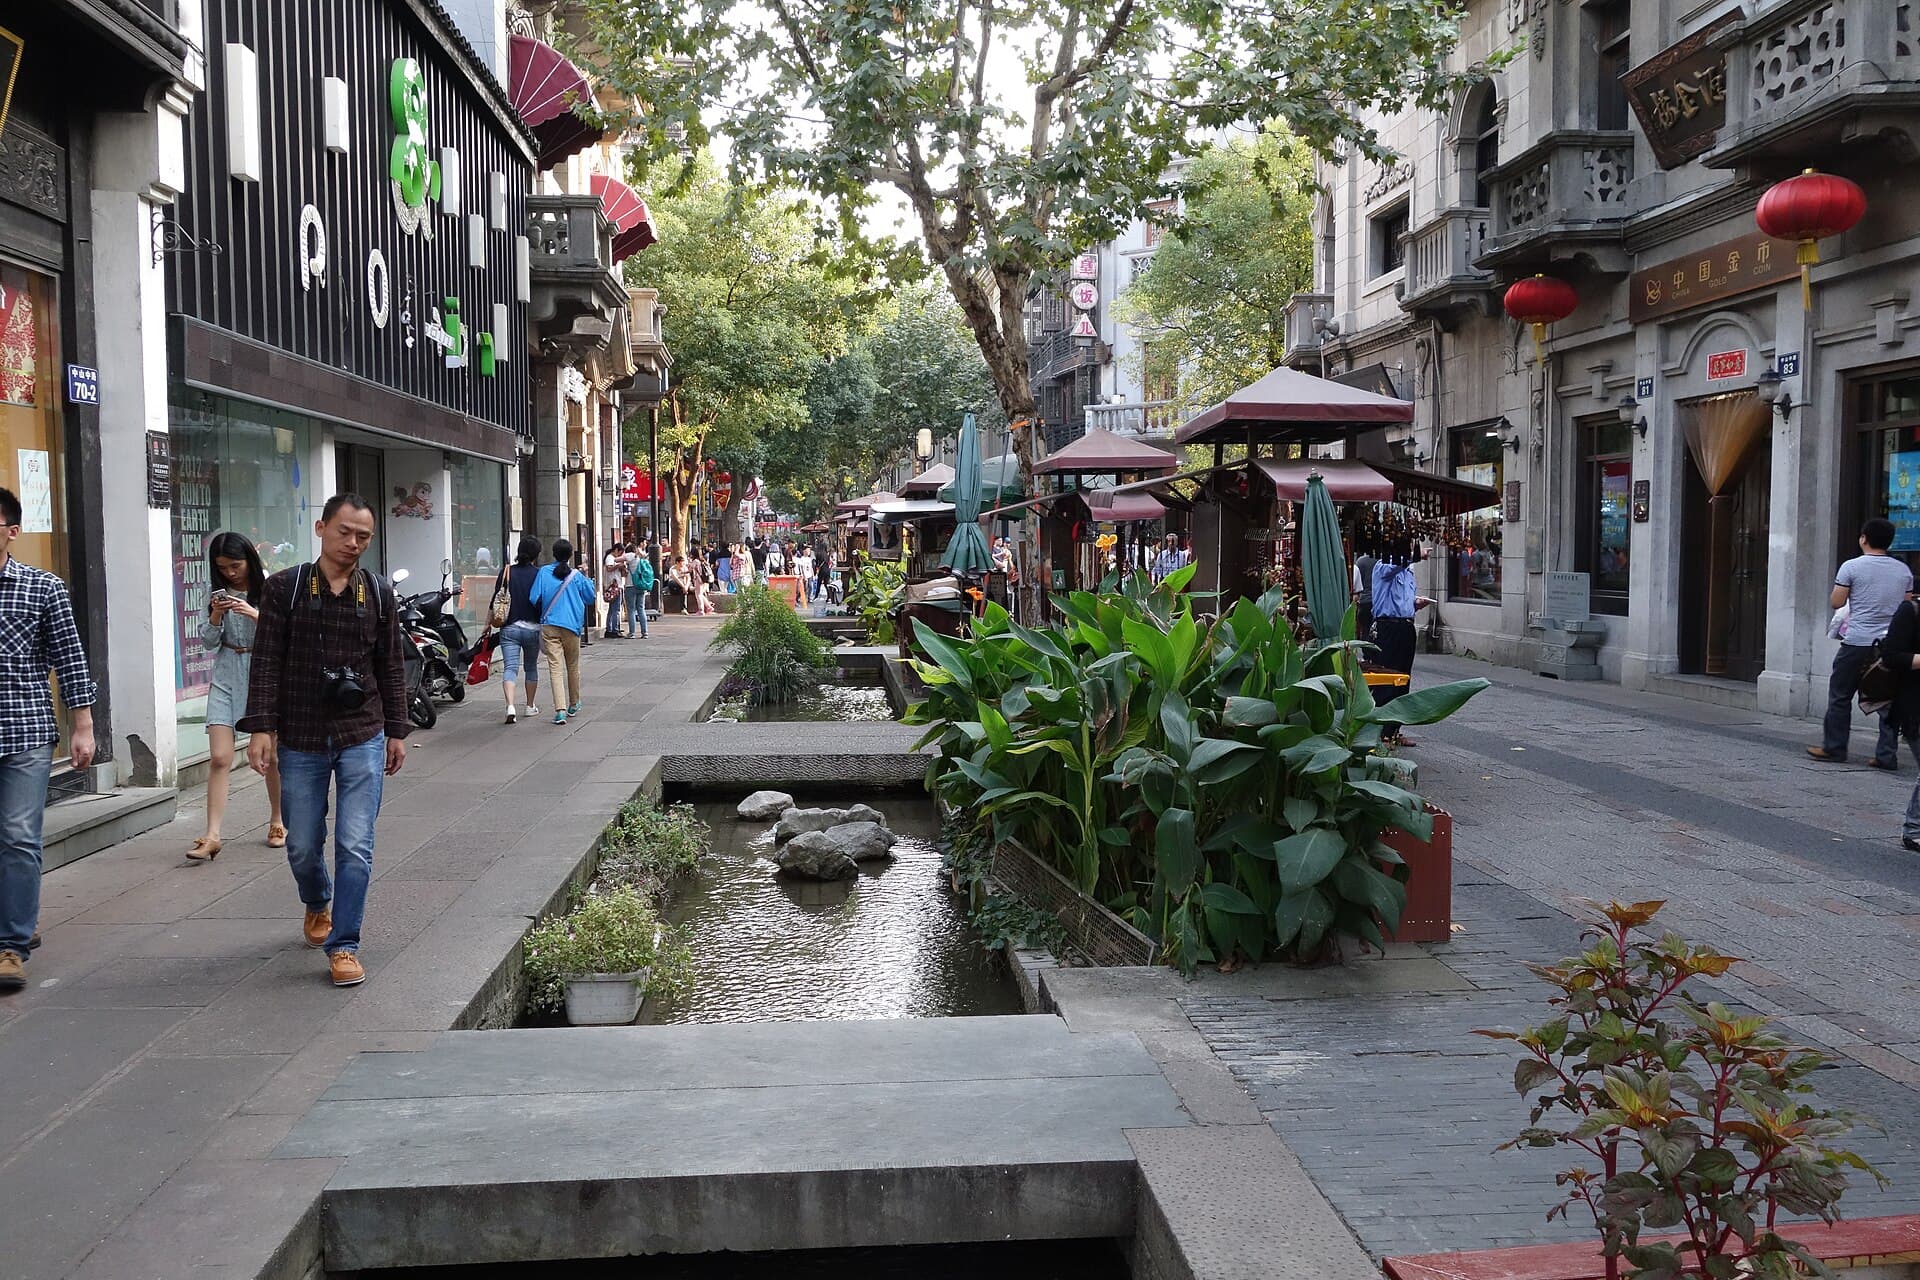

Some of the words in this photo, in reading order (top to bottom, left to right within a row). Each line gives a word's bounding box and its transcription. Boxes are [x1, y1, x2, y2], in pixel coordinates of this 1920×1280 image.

[1673, 240, 1770, 289] 中国金币
[1708, 276, 1727, 289] GOLD
[1753, 263, 1771, 275] COIN
[1079, 257, 1094, 335] 皇饭儿
[1784, 362, 1793, 374] 83
[75, 382, 96, 401] 70-2
[1641, 386, 1649, 395] 81
[180, 454, 202, 478] 2012
[180, 482, 199, 506] RUN
[200, 483, 212, 507] TO
[181, 508, 209, 532] EARTH
[182, 533, 202, 557] NEW
[184, 560, 211, 584] AUTU
